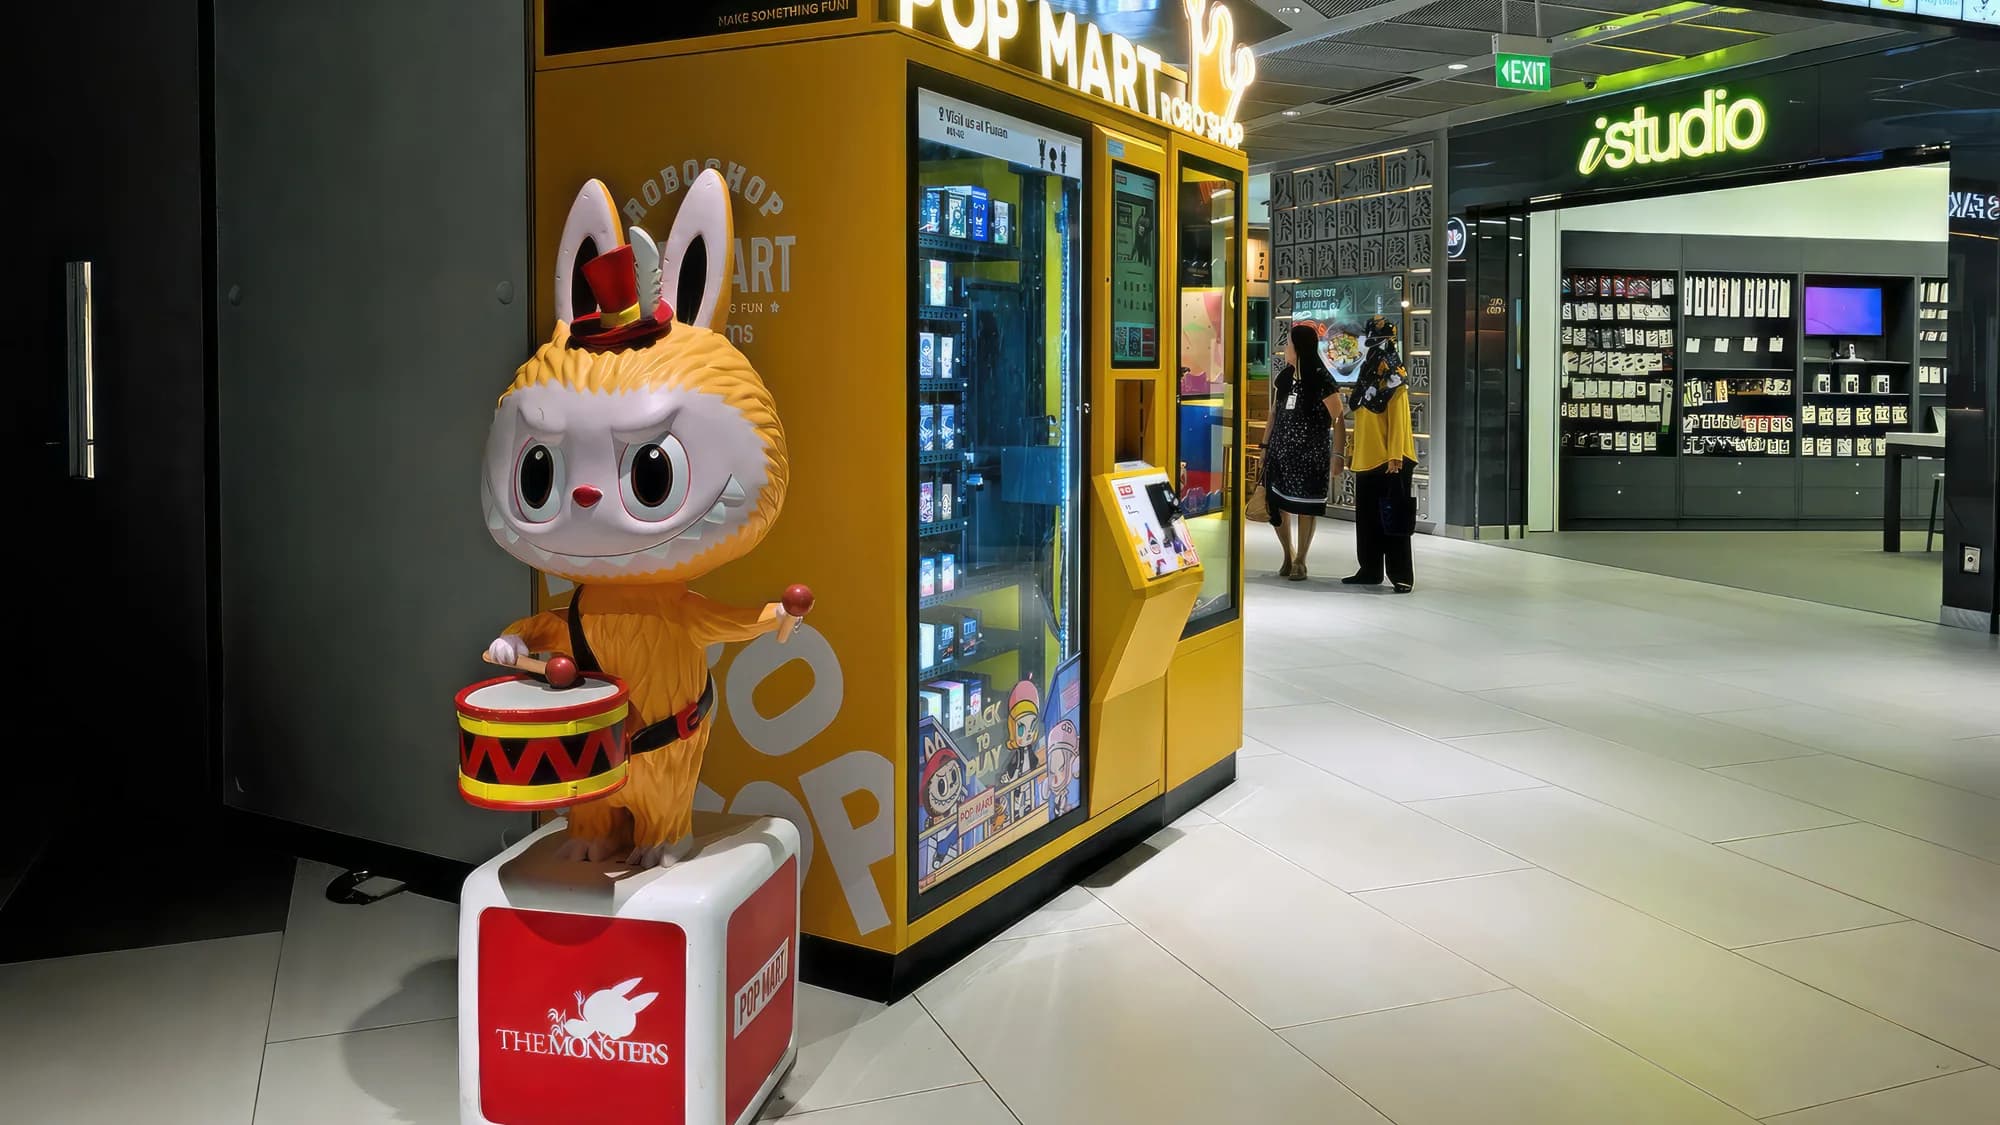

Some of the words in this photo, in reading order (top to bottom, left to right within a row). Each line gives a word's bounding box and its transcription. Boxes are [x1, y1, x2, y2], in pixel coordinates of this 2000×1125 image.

[718, 13, 749, 26] MAKE
[751, 3, 819, 22] SOMETHING
[1039, 1, 1161, 118] MART
[1510, 60, 1546, 87] EXIT
[965, 117, 974, 129] us
[1160, 91, 1205, 135] ROBO
[1207, 112, 1244, 150] SHOP
[1578, 89, 1766, 176] istudio
[741, 303, 763, 313] FUN
[965, 700, 1002, 738] BACK
[976, 732, 991, 752] TO
[965, 745, 1002, 785] PLAY
[739, 977, 760, 1027] POP
[761, 950, 786, 1007] MART
